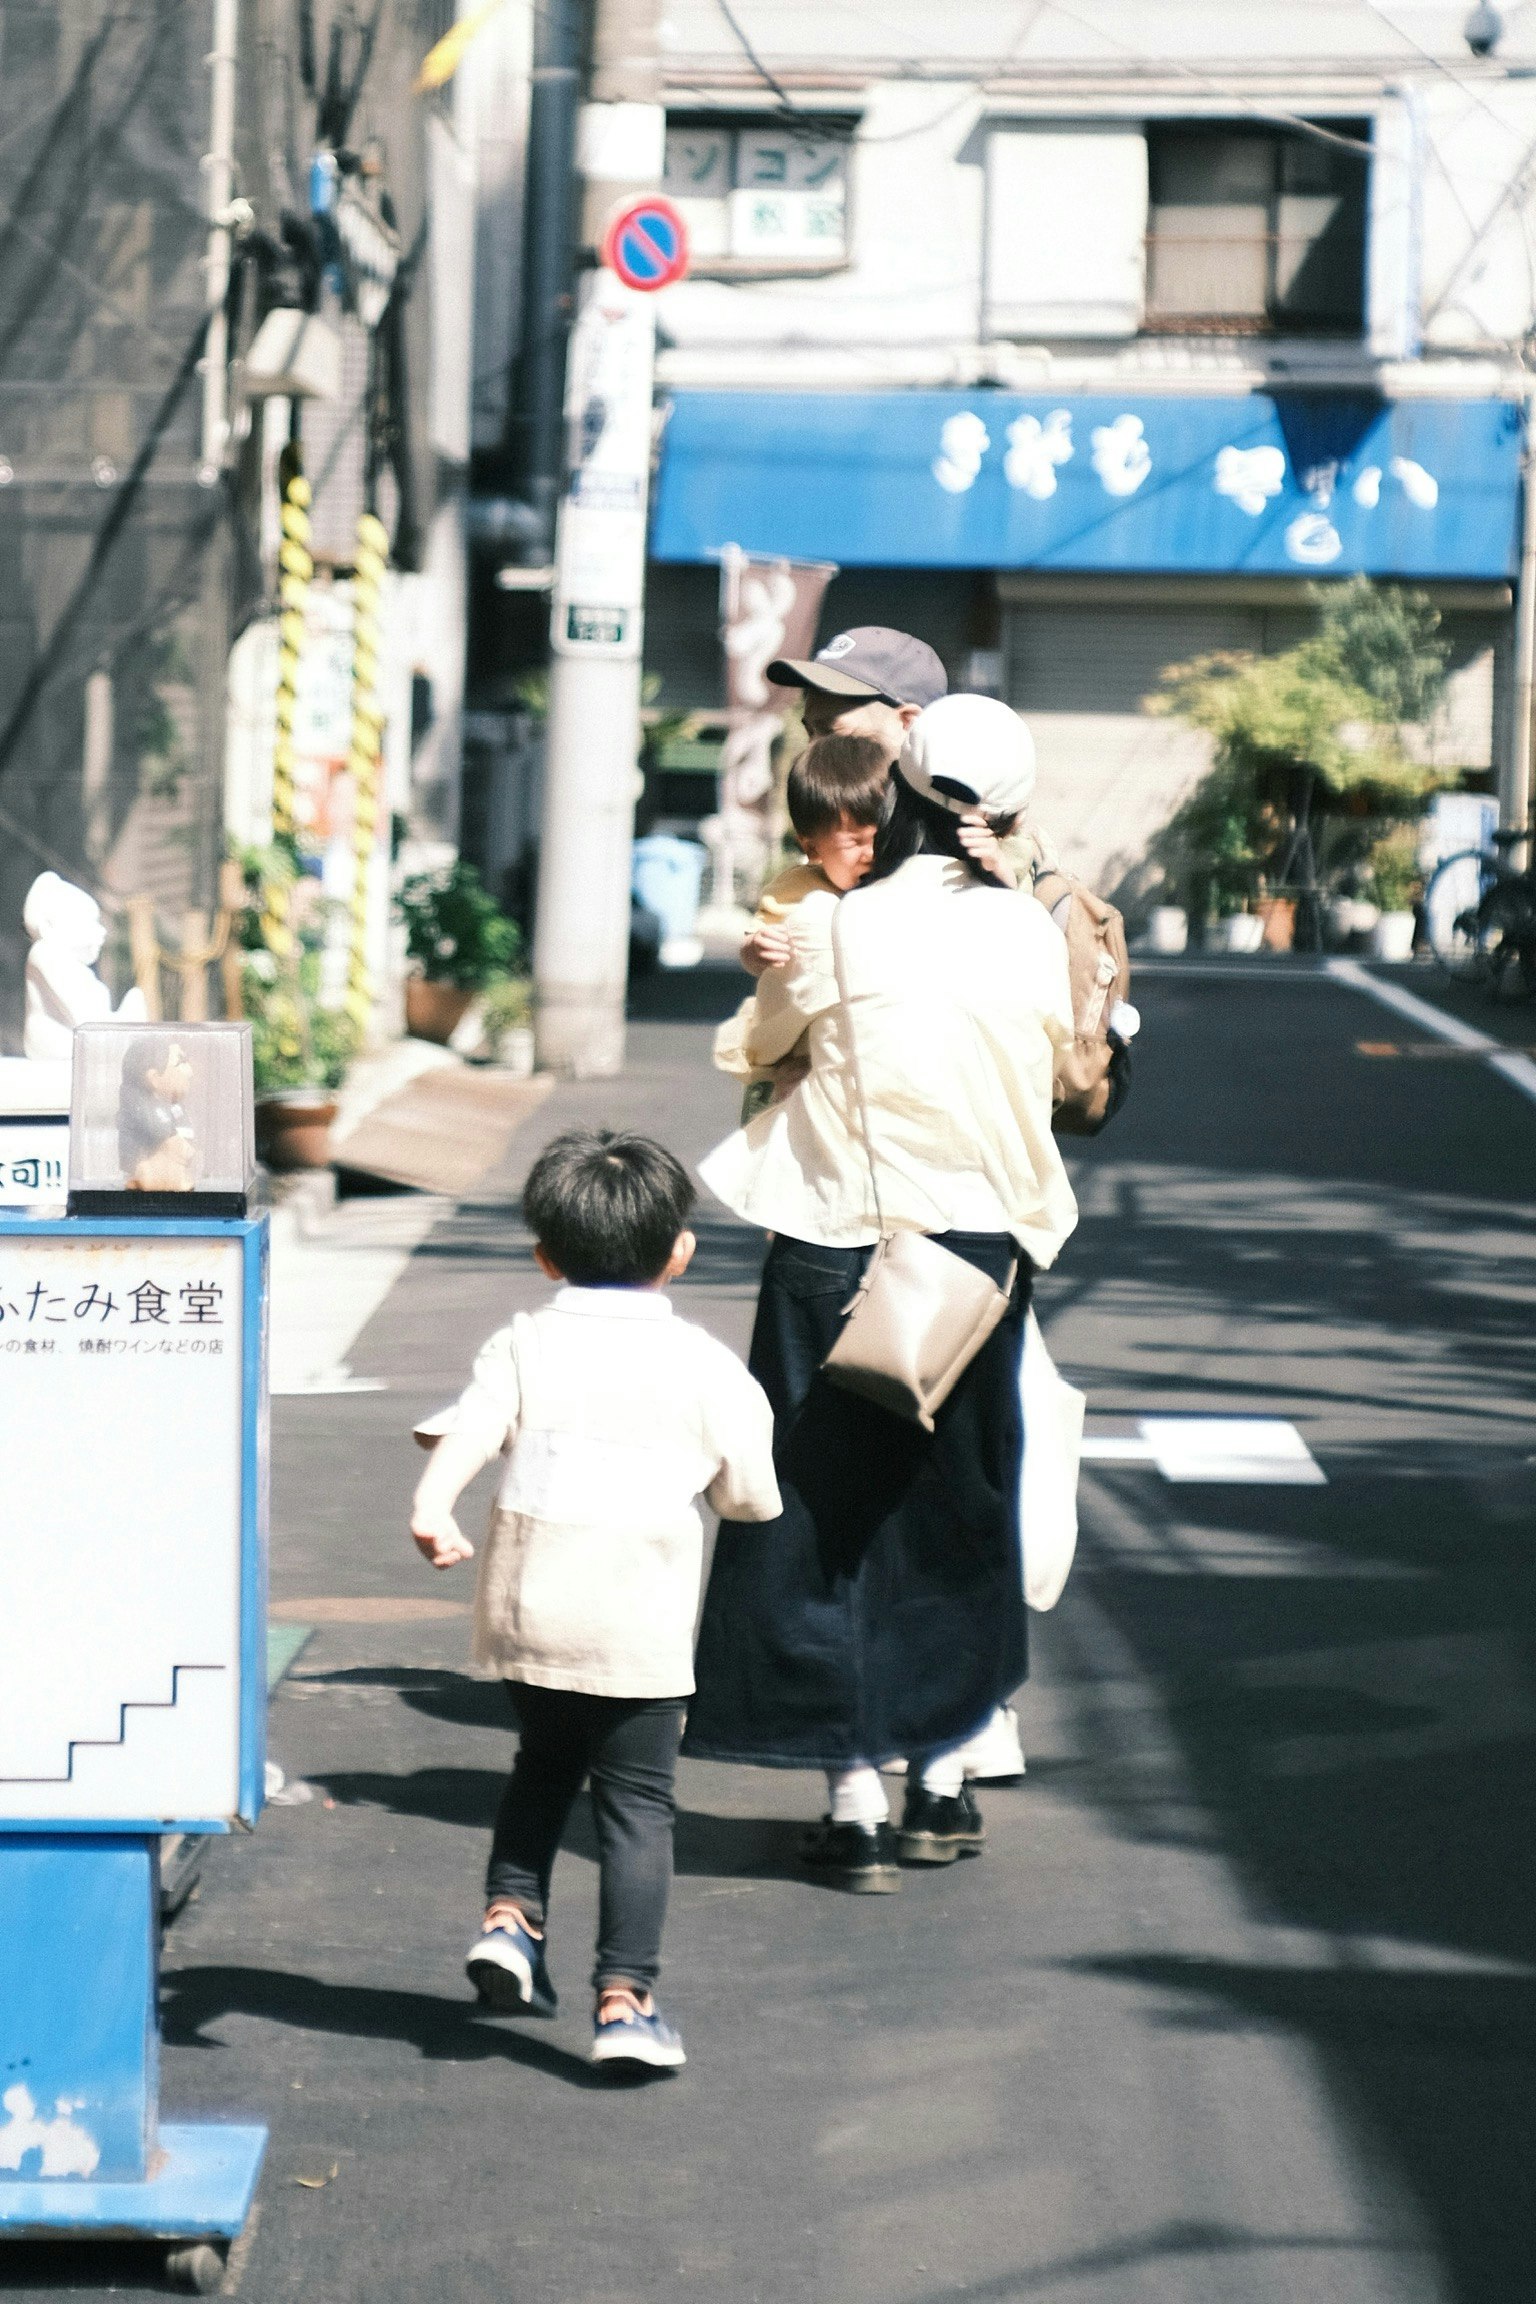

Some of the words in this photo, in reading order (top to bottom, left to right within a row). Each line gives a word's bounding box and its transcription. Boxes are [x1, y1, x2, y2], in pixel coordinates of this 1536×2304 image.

[664, 144, 840, 184] ソコン
[0, 1158, 62, 1189] 可!!
